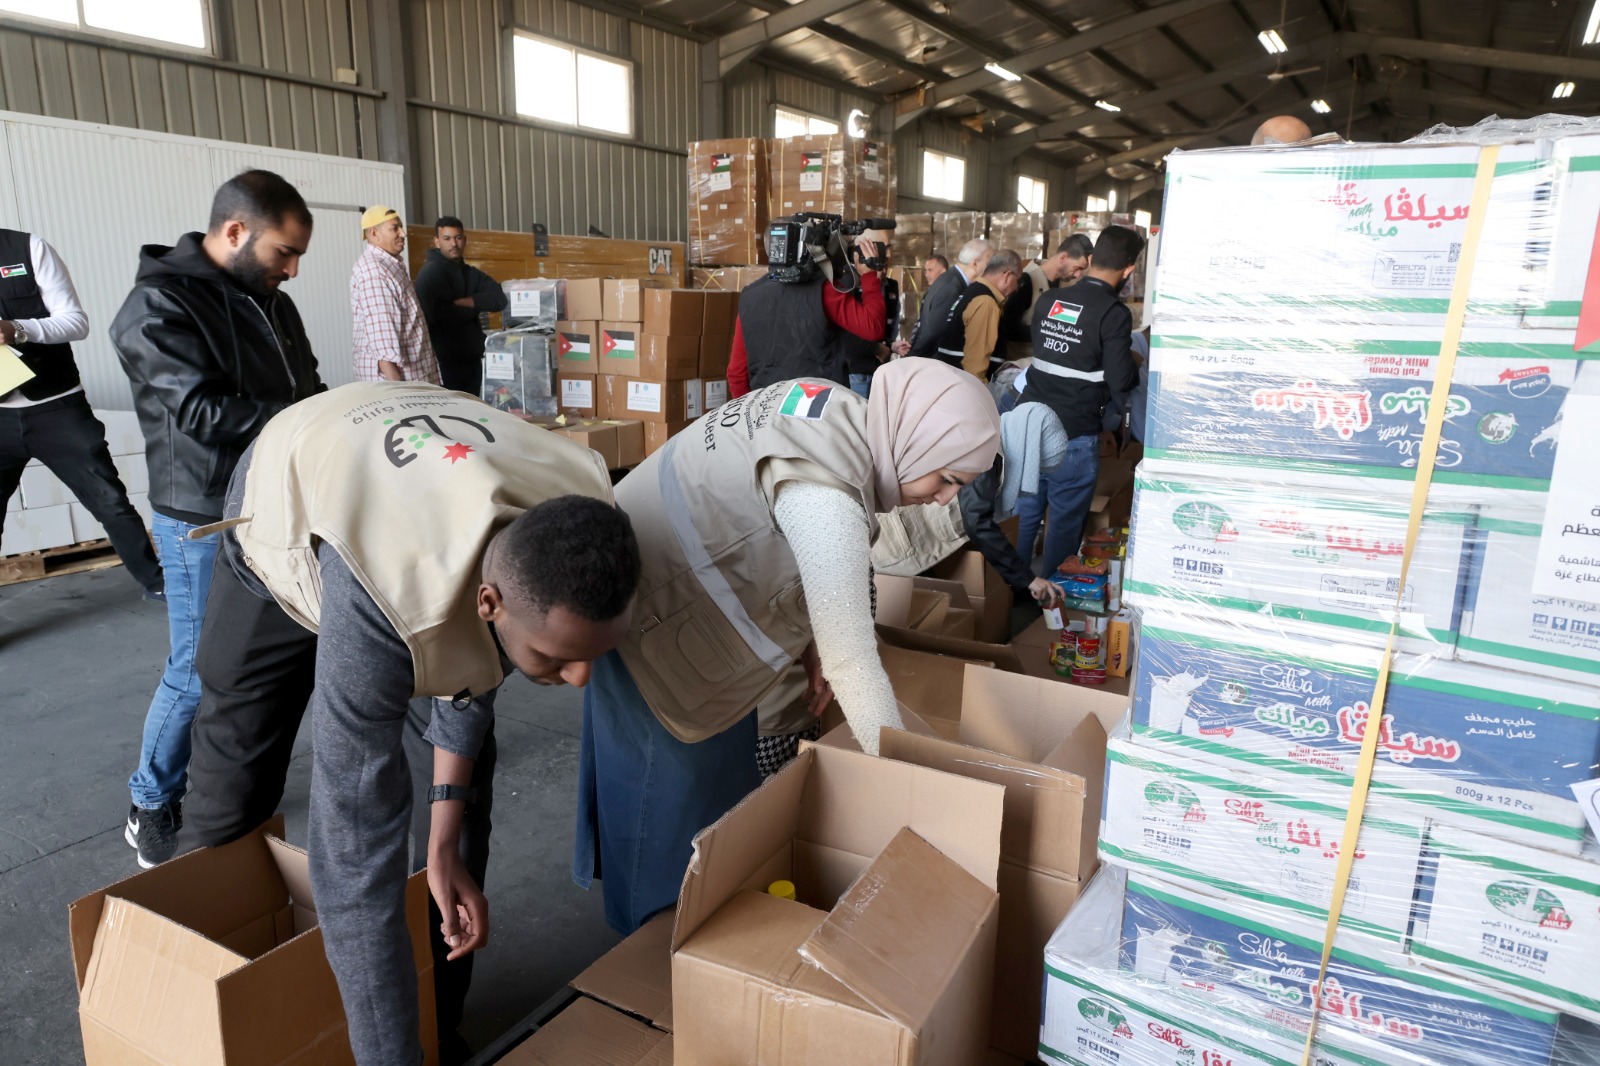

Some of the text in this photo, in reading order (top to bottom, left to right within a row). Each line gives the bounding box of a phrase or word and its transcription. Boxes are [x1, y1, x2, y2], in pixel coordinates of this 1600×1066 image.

[649, 248, 672, 275] CAT
[1043, 337, 1069, 353] JHCO
[1405, 358, 1430, 368] Milk
[1369, 366, 1421, 377] Full Cream
[352, 401, 458, 425] وزارة الشباب
[1385, 438, 1463, 467] Sva
[1554, 569, 1574, 580] غزة
[1531, 598, 1555, 606] كيس
[1259, 663, 1325, 696] Silva
[1304, 695, 1333, 711] Milk
[1464, 712, 1536, 728] حليب مجفف
[1465, 727, 1536, 739] كامل الدسم
[1455, 785, 1483, 802] 800g
[1497, 795, 1512, 806] 12
[1514, 799, 1535, 812] Pcs
[1481, 919, 1502, 928] كيس
[1542, 919, 1568, 929] MILK
[1238, 932, 1297, 965] Silva
